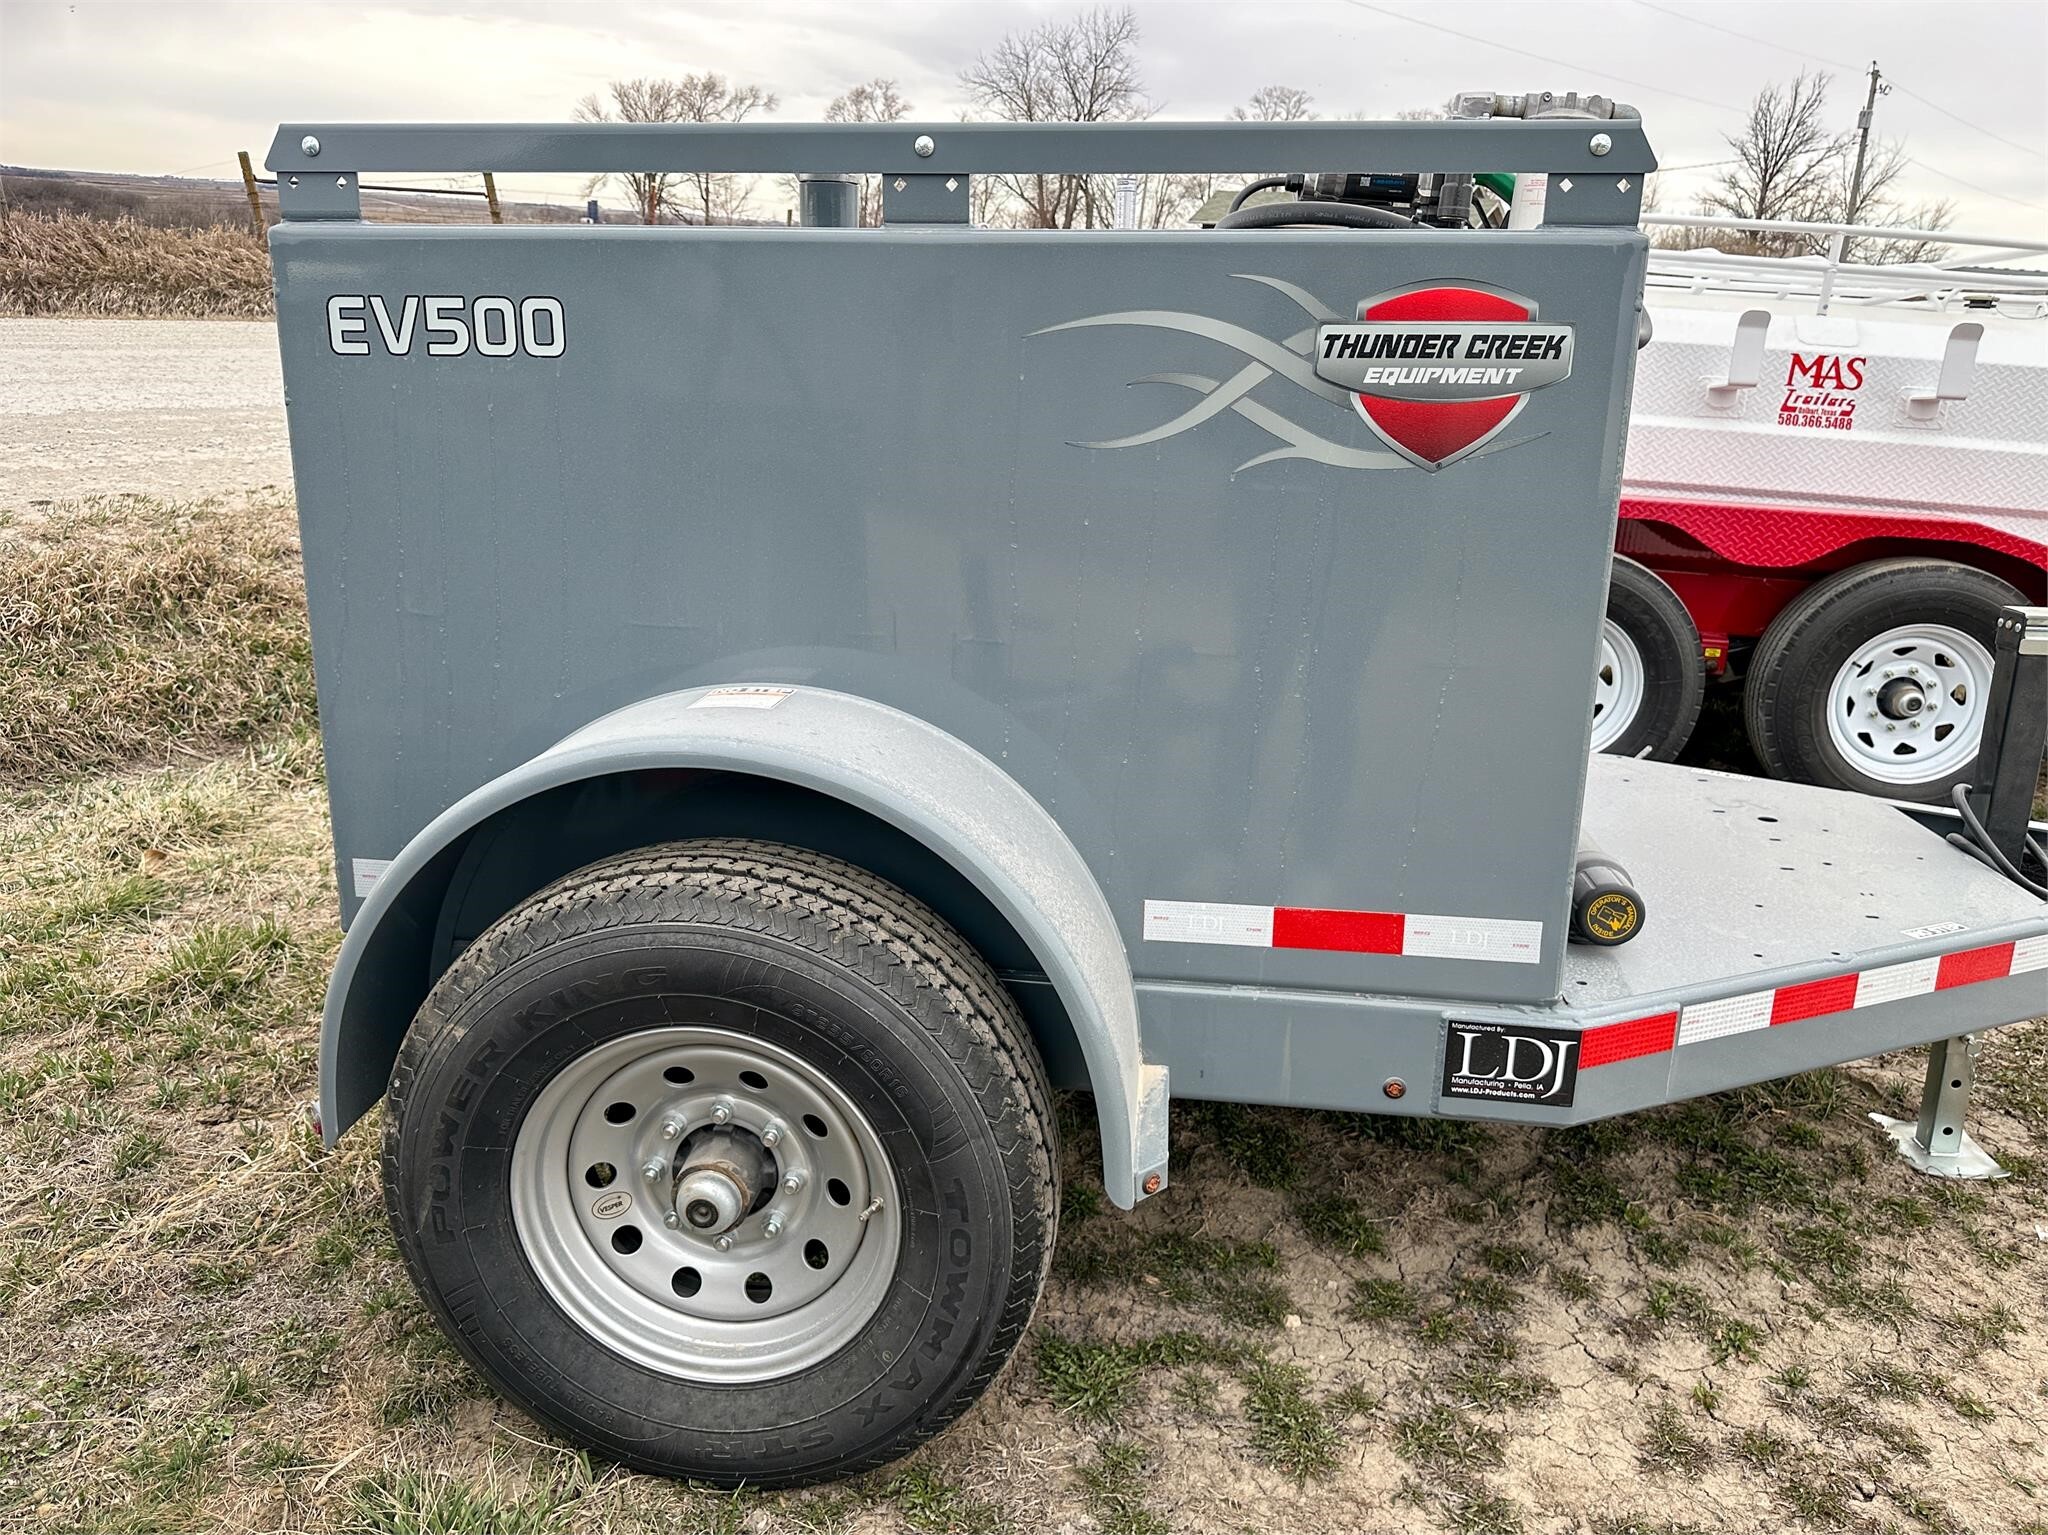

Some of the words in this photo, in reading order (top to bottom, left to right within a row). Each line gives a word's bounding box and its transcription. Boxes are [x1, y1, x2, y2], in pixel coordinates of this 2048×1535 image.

[327, 295, 567, 357] EV500
[1322, 333, 1461, 360] THUNDER
[1464, 333, 1568, 360] CREEK
[1362, 366, 1523, 386] EQUIPMENT
[1784, 352, 1867, 391] MAS
[1780, 388, 1856, 417] Trailers
[1777, 413, 1853, 431] 580.366.5488
[1592, 923, 1614, 937] INSIDE
[1451, 1022, 1495, 1031] Manufactured
[1452, 1031, 1578, 1099] LDJ
[1450, 1086, 1535, 1099] www.LDJ-Products.com
[1451, 1077, 1505, 1089] Manufacturing
[429, 1038, 499, 1243] POWER
[512, 966, 668, 1036] KING
[851, 1176, 972, 1429] TOWMAX
